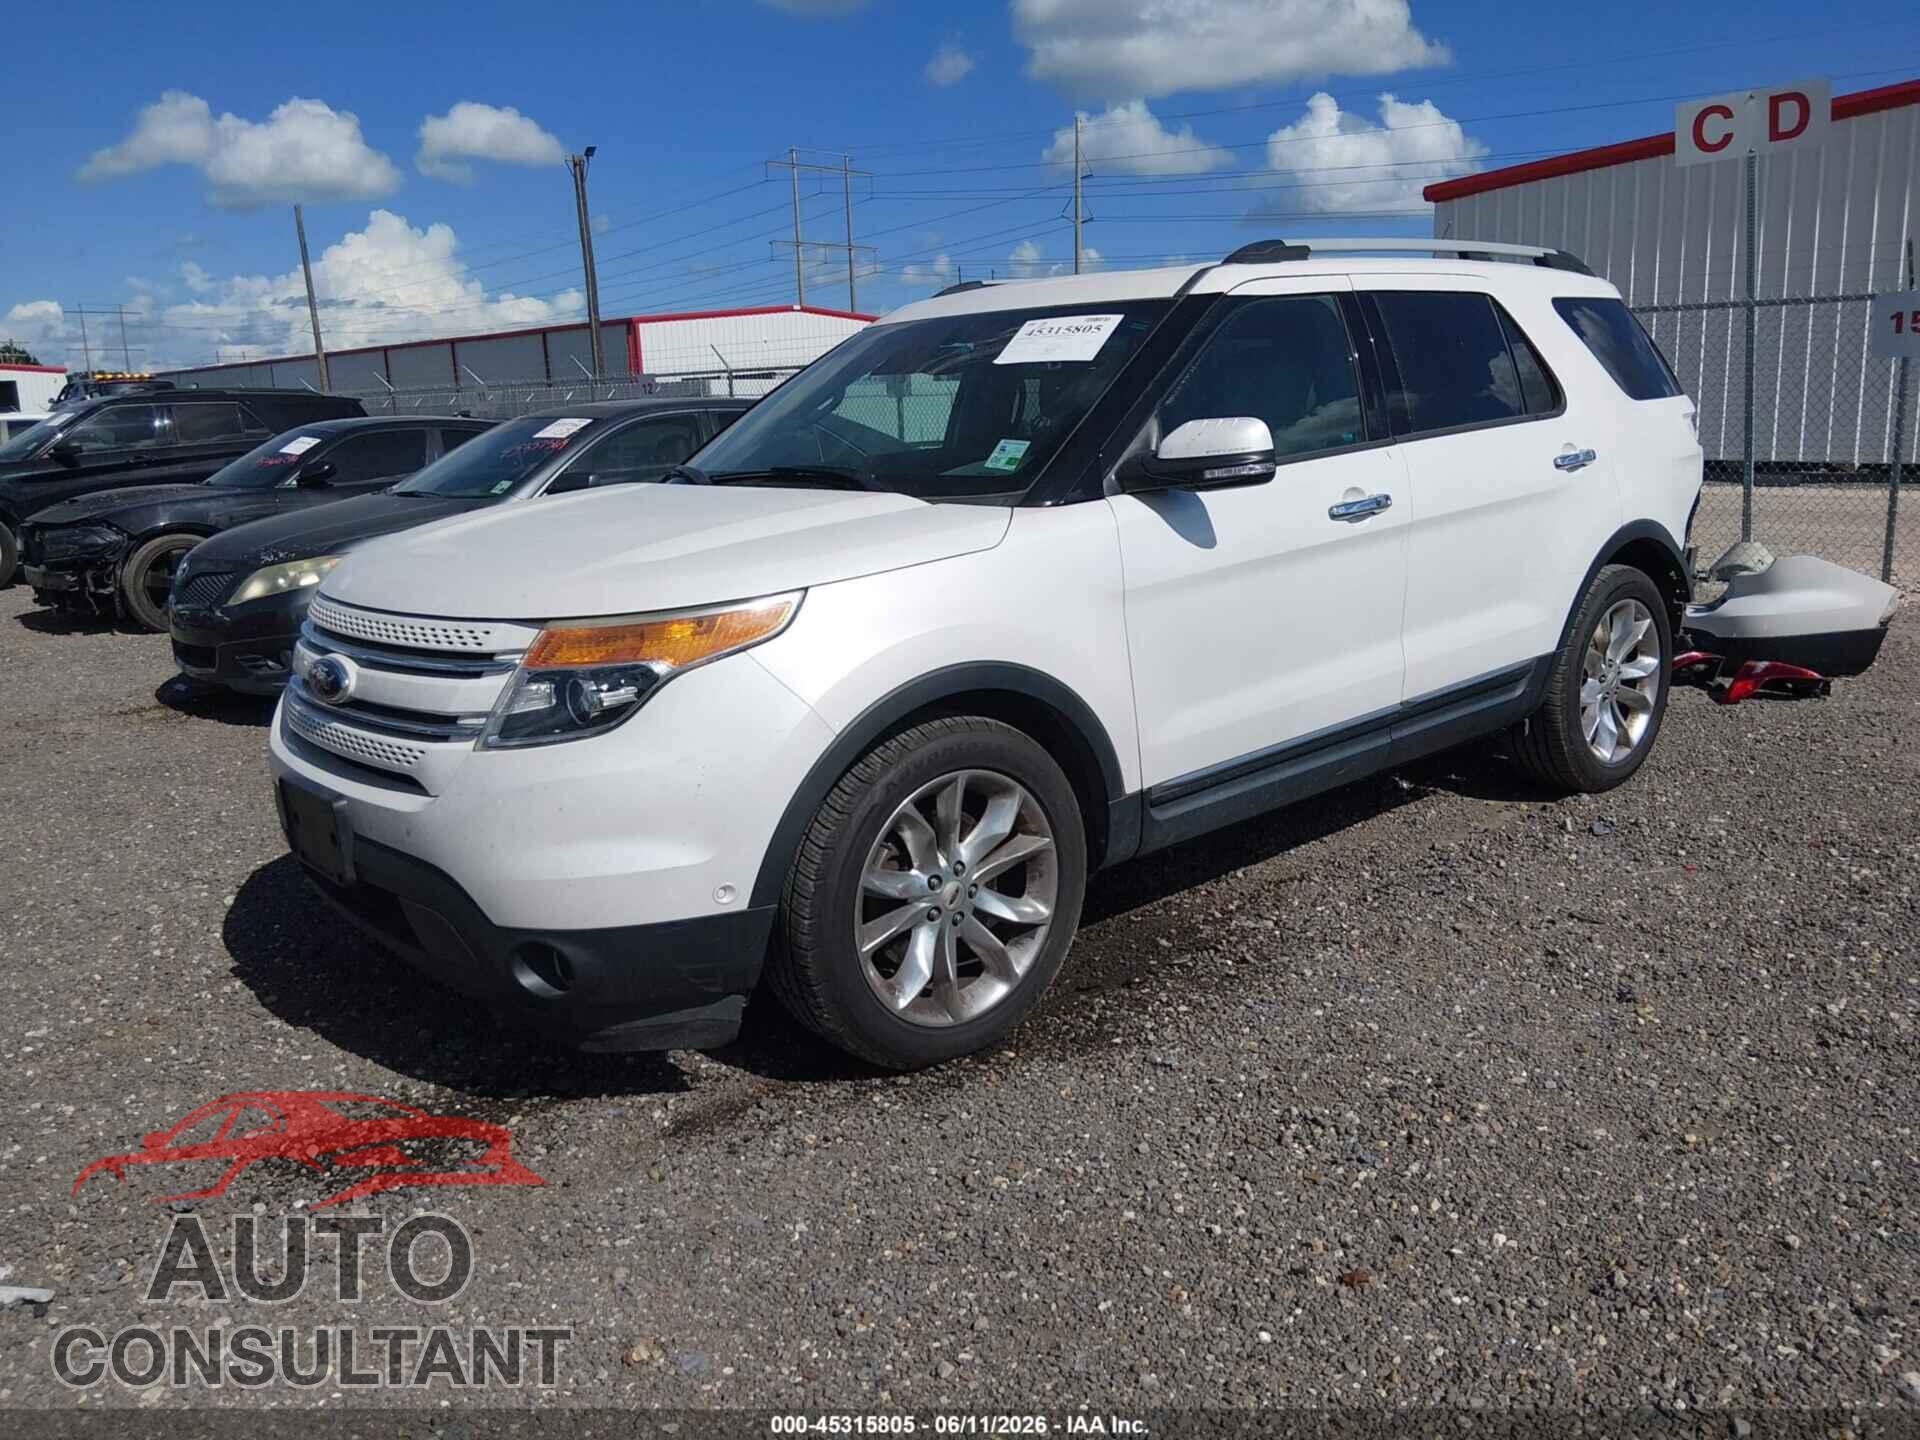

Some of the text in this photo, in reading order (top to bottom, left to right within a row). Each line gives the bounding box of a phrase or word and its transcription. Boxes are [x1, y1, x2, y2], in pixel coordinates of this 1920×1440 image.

[1692, 104, 1734, 153] C
[1768, 91, 1811, 142] D
[1025, 324, 1102, 337] 45315805
